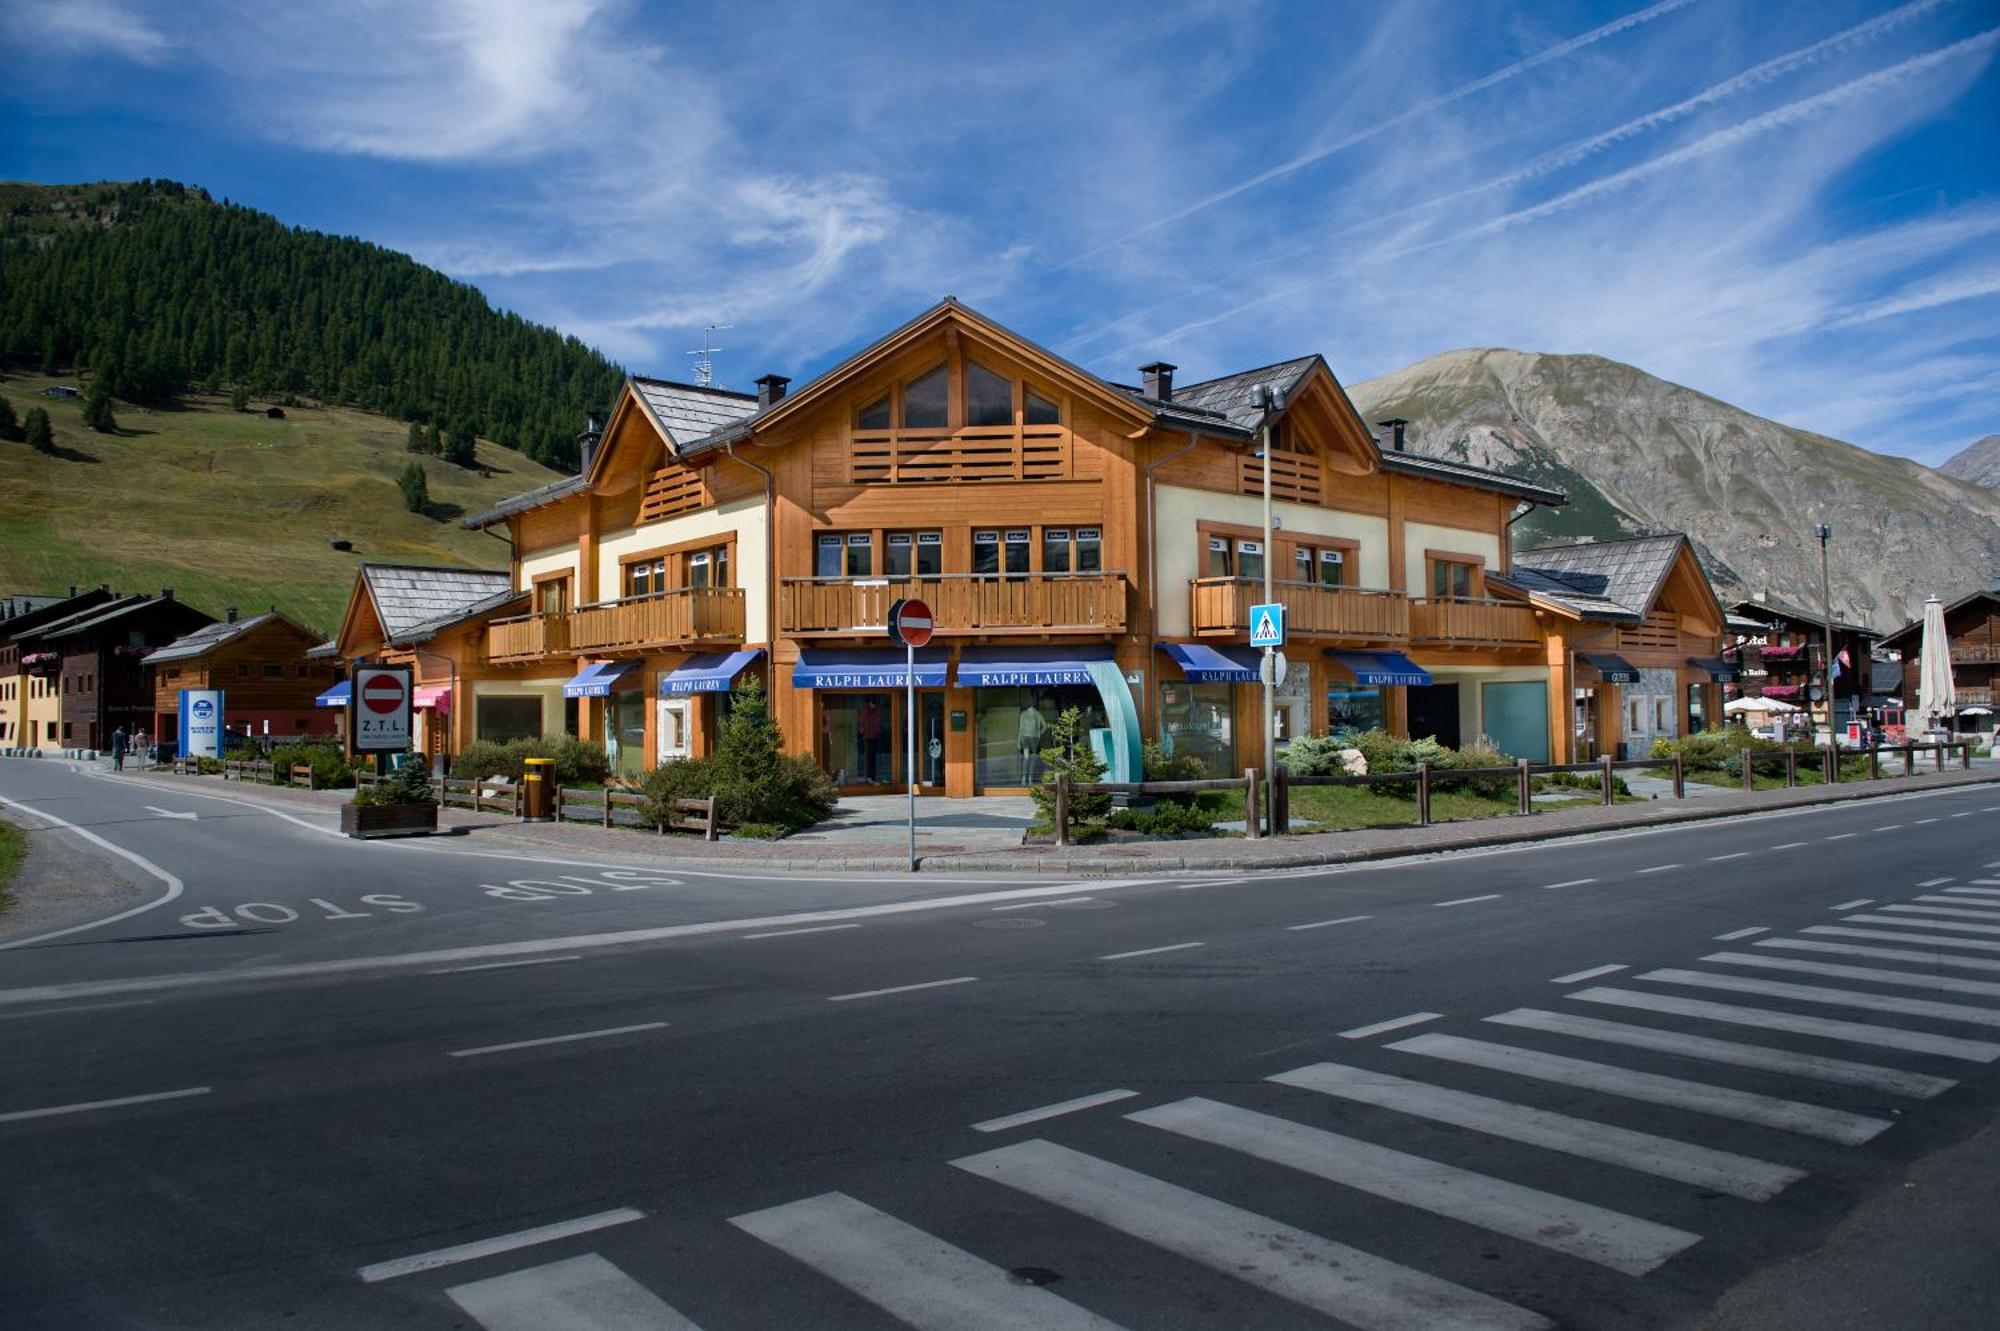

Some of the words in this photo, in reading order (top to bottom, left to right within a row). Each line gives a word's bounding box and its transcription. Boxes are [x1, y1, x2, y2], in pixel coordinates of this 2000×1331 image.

[816, 674, 861, 687] RALPH
[982, 673, 1028, 685] RALPH
[1035, 671, 1091, 684] LAUREN
[1202, 671, 1232, 681] RALPH
[1236, 671, 1262, 681] LAUR
[1369, 674, 1393, 685] RALPH
[1394, 674, 1422, 686] LAUREN
[1611, 672, 1630, 682] GUESS
[672, 681, 692, 692] RALPH
[694, 679, 720, 691] LAUREN
[363, 720, 405, 731] Z.T.L.
[479, 871, 686, 900] STOP
[179, 894, 427, 928] STOP
